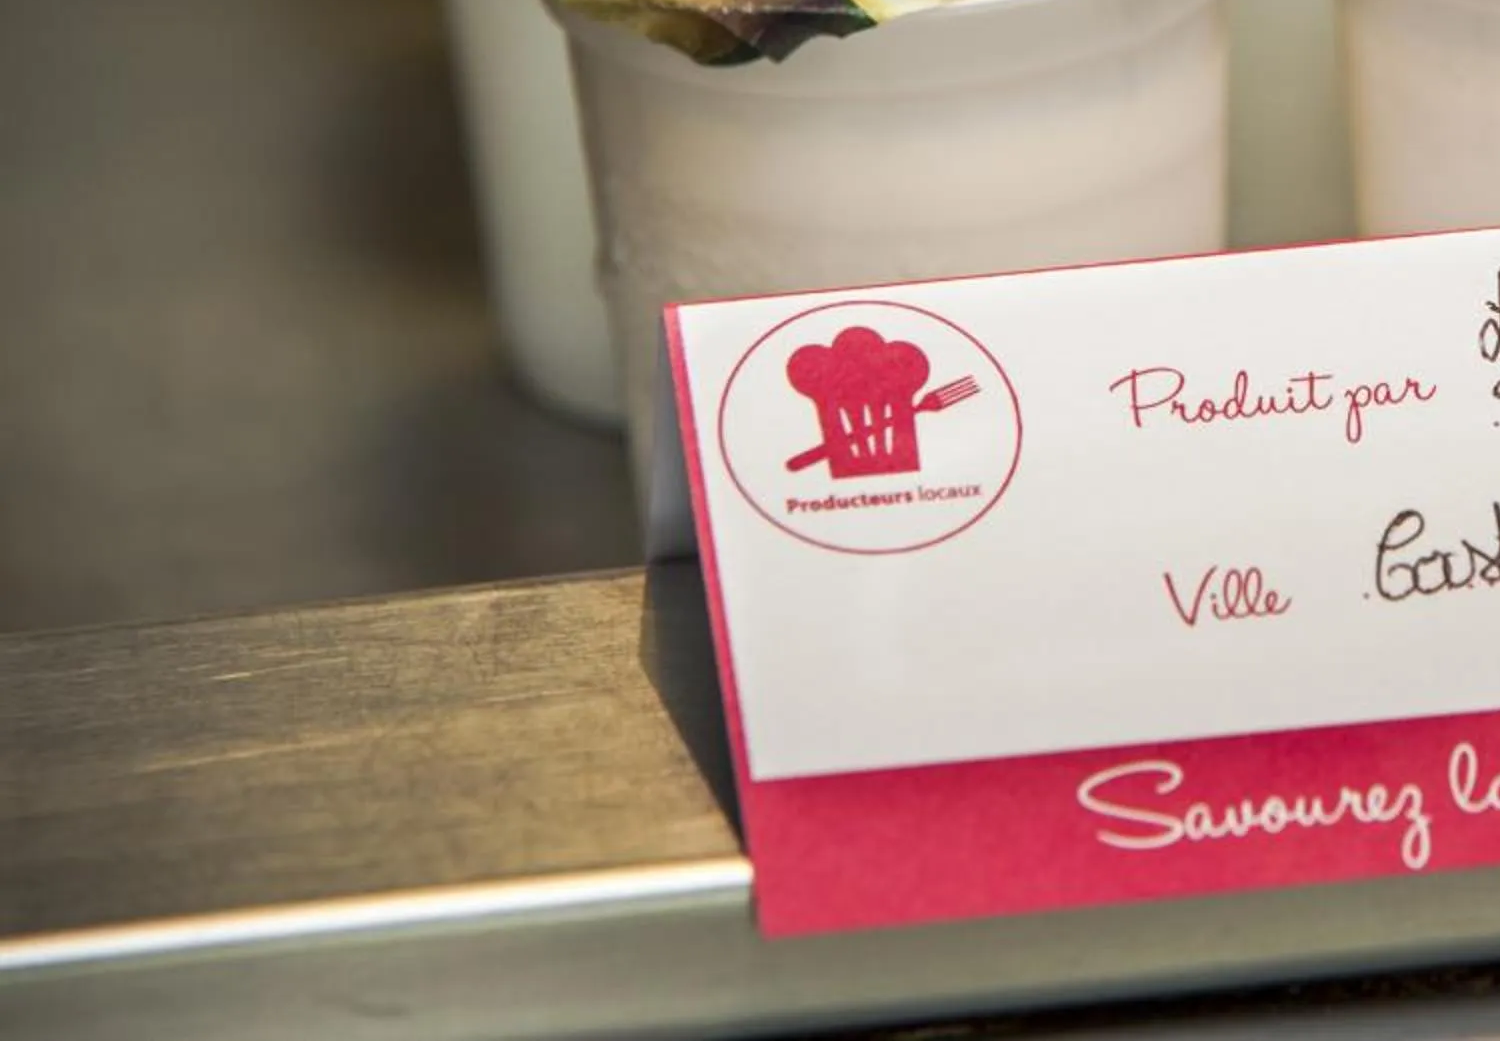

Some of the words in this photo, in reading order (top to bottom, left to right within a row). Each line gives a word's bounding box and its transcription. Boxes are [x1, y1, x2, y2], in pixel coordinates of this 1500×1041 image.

[1110, 367, 1333, 427] Produit
[1344, 377, 1437, 443] par
[786, 491, 914, 514] Producteurs
[917, 484, 982, 504] locaux
[1164, 565, 1291, 627] Ville
[1077, 760, 1432, 869] Savourez
